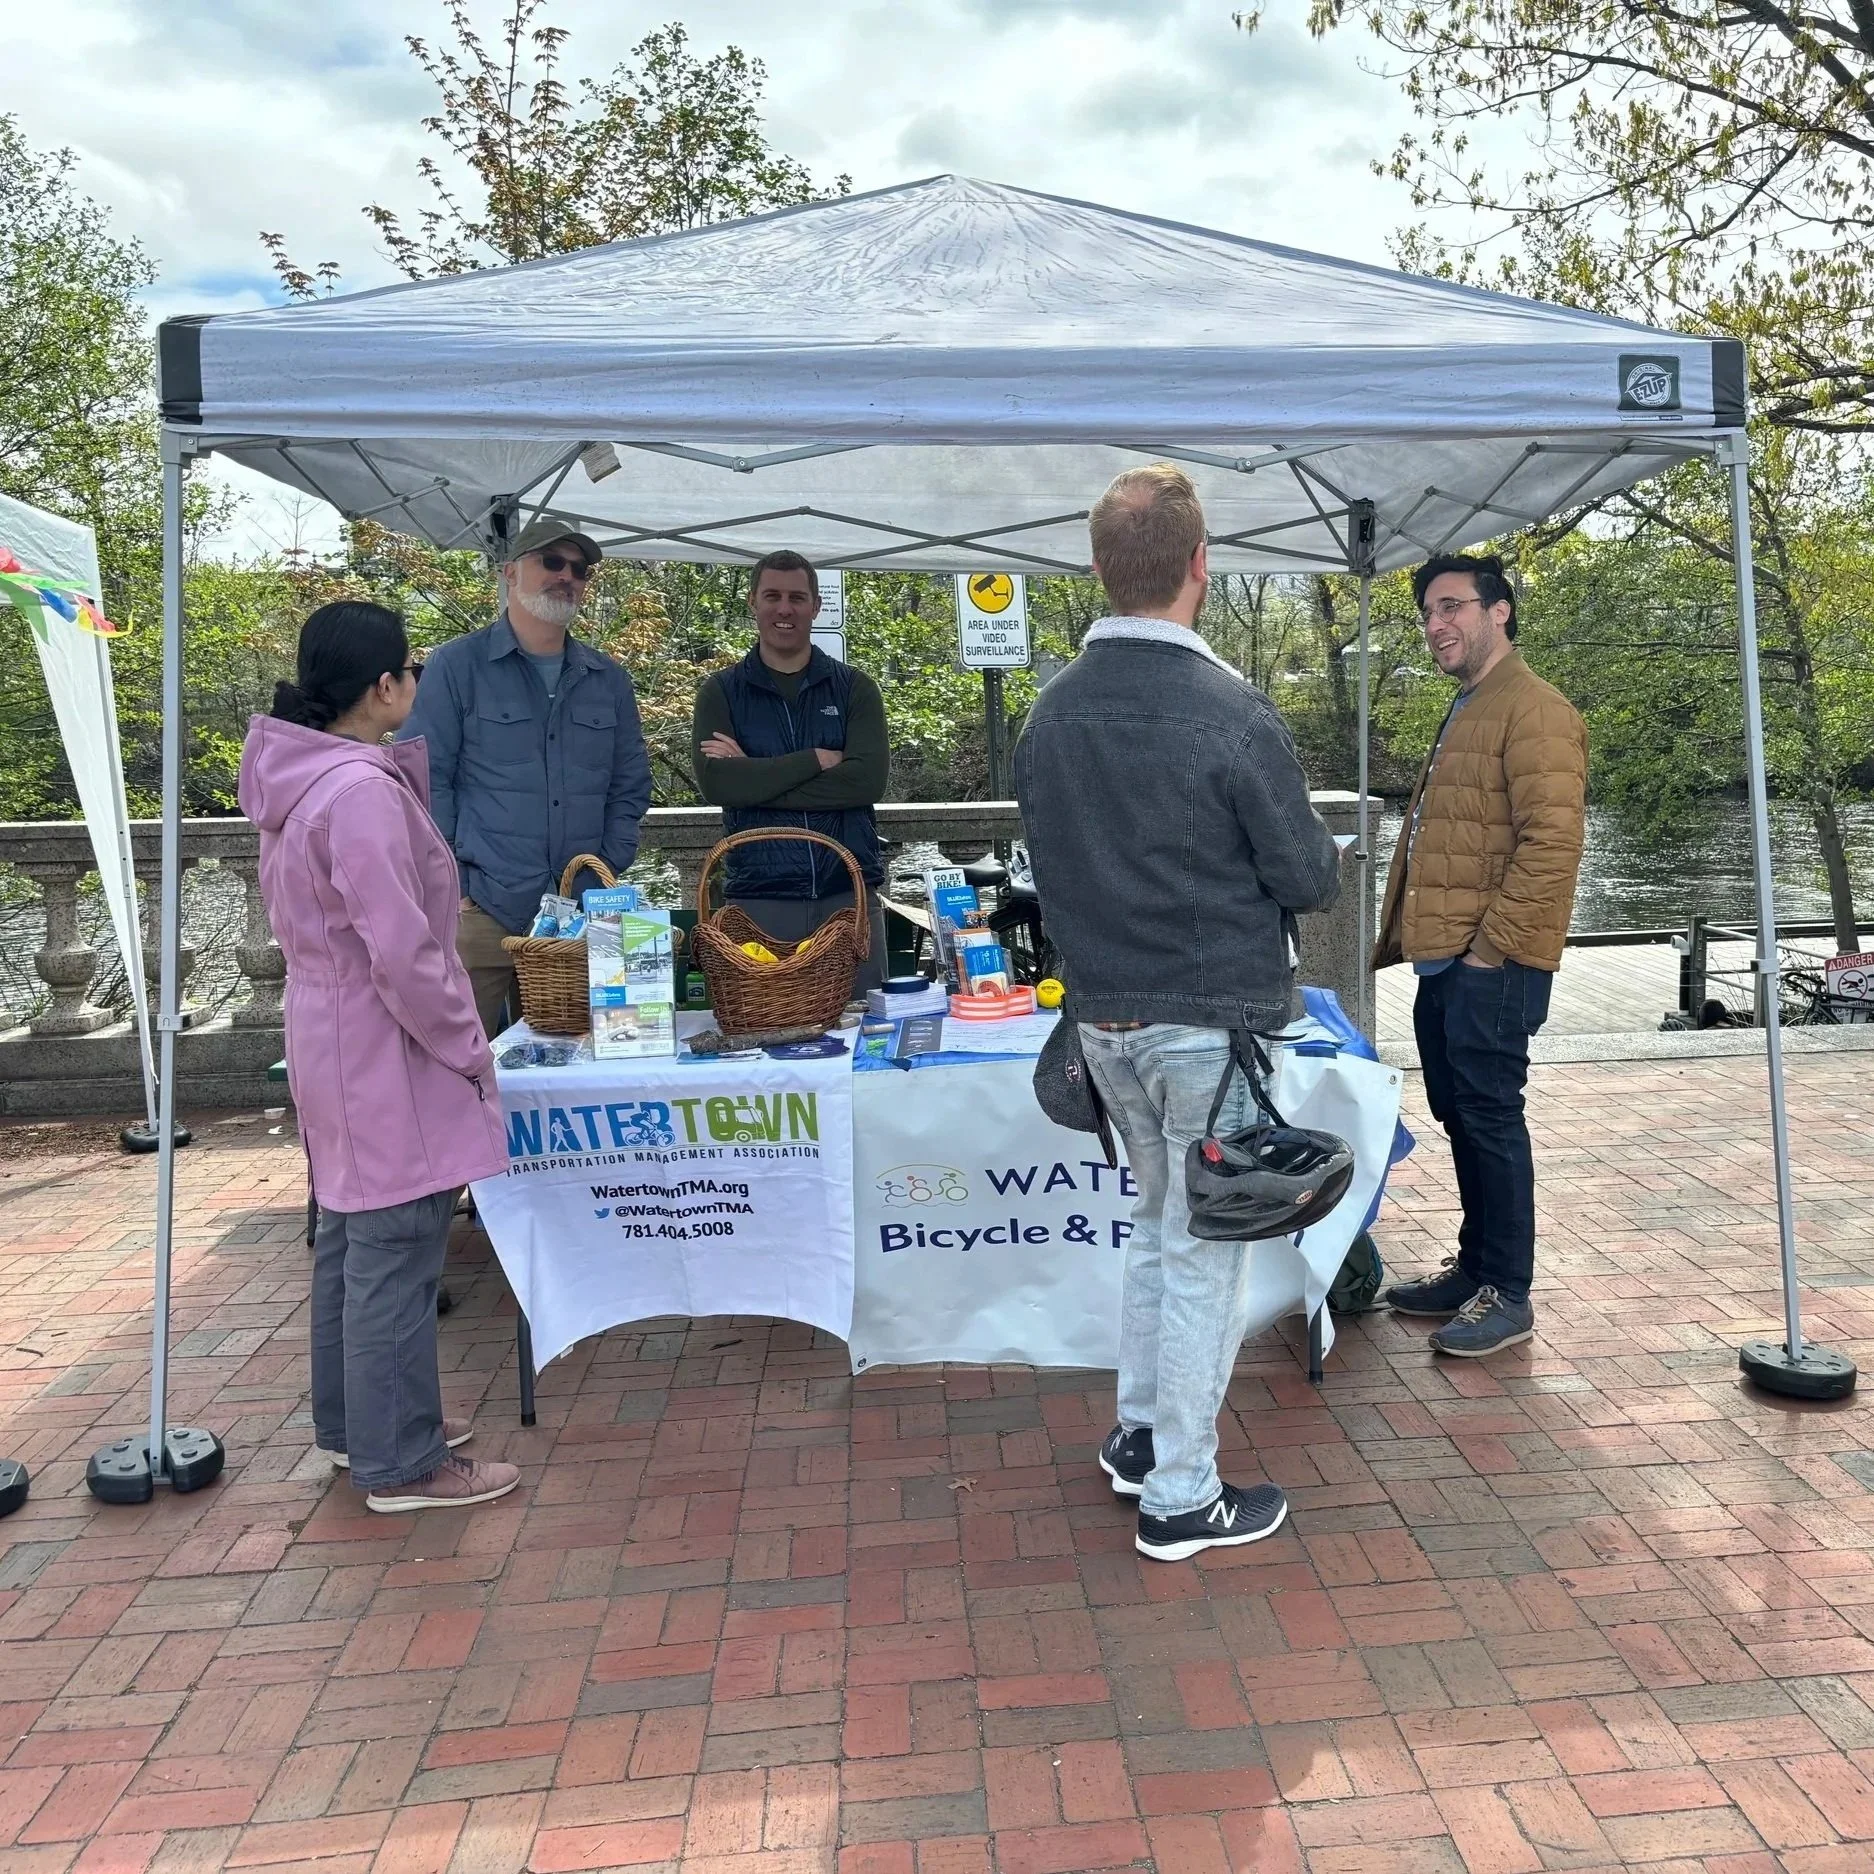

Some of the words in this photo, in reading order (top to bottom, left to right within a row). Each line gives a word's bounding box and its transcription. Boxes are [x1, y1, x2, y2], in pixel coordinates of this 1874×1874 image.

[967, 620, 989, 630] AREA
[992, 620, 1019, 630] UNDER
[982, 633, 1007, 643] VIDEO
[965, 645, 1025, 656] SURVEILLANCE
[937, 881, 961, 889] BIKE!
[588, 896, 604, 904] BIKE
[606, 895, 630, 903] SAFETY
[1836, 953, 1873, 970] DANGER
[635, 1148, 724, 1164] MANAGEMENT
[734, 1146, 819, 1159] ASSOCIATION
[590, 1179, 750, 1199] WatertownTMA.org
[615, 1202, 754, 1219] @WatertownTMA
[622, 1221, 734, 1240] 781.404.5008
[880, 1218, 1050, 1253] Bicycle
[1062, 1214, 1098, 1246] &
